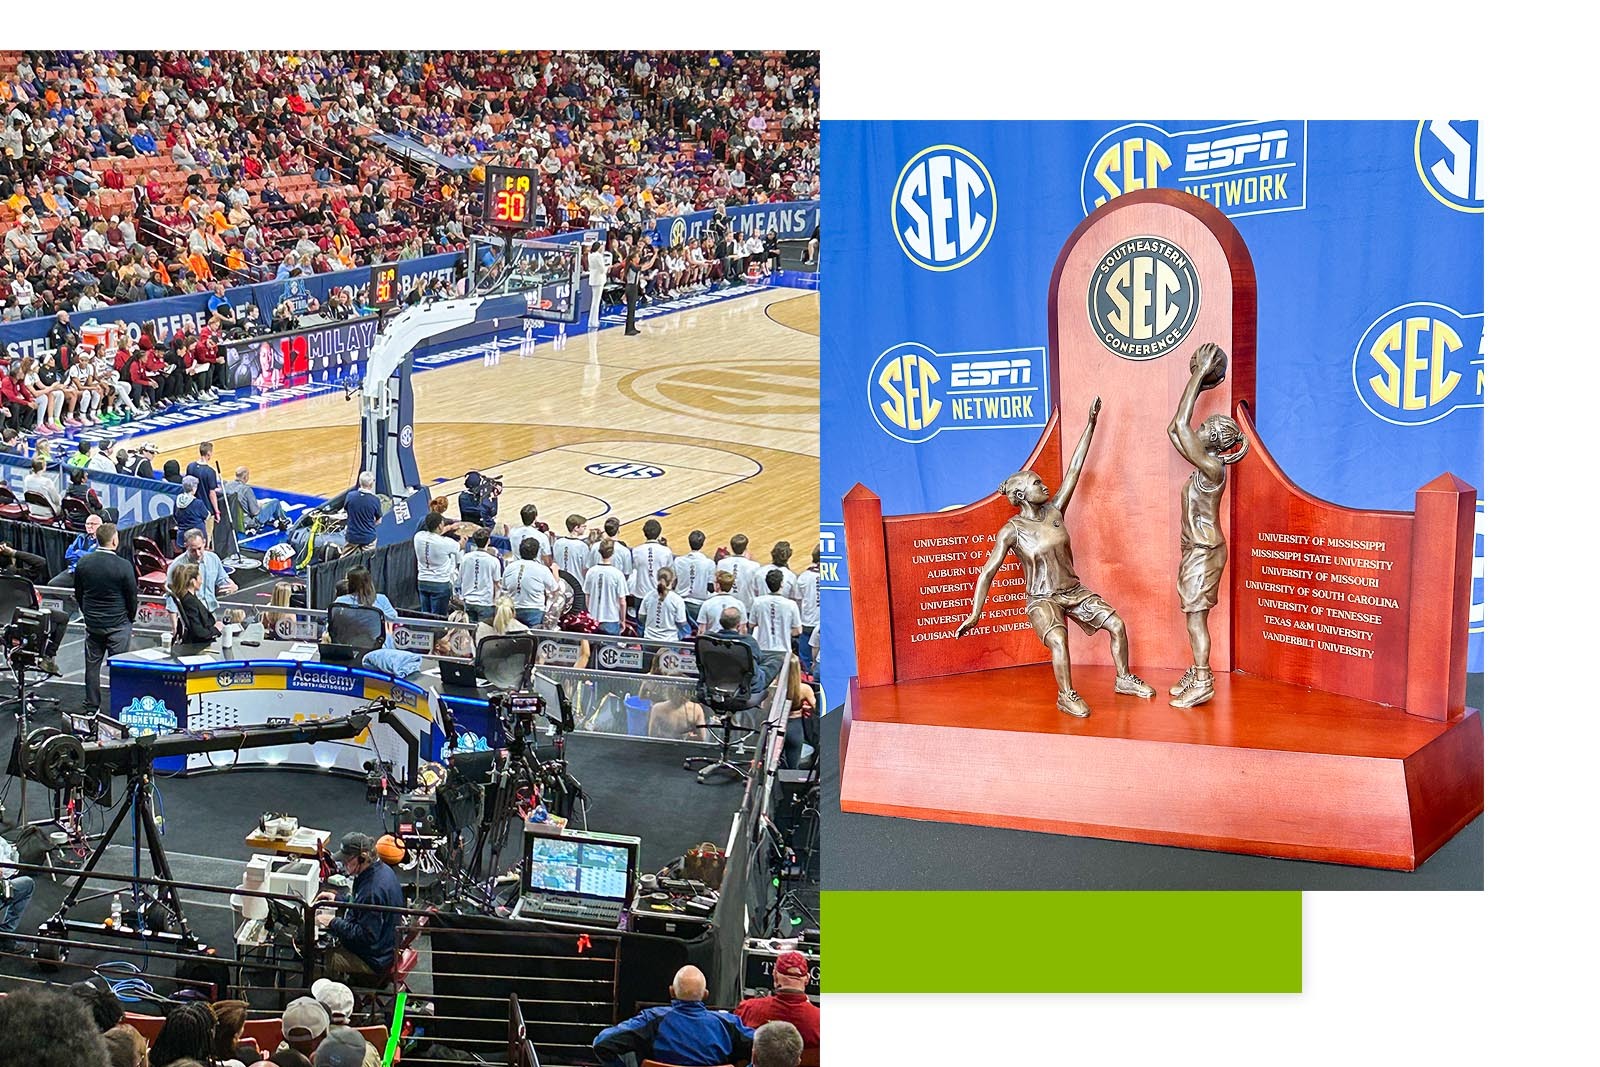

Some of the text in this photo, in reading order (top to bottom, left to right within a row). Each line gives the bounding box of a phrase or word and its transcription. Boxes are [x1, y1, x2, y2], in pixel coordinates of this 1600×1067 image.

[1185, 129, 1288, 172] ESPN
[900, 155, 987, 262] SEC
[741, 209, 806, 238] MEANS
[1101, 241, 1187, 274] SOUTHEASTERN
[1106, 257, 1181, 340] SEC
[281, 321, 379, 375] 12 MILAY
[1105, 328, 1182, 355] CONFERENCE
[1369, 317, 1463, 409] SEC
[878, 354, 942, 430] SEC
[951, 359, 1032, 387] ESPN
[952, 396, 1033, 420] NETWORK
[914, 536, 969, 548] UNIVERSITY
[972, 535, 984, 544] OF
[1258, 532, 1386, 552] UNIVERSITY OF MISSISSIPPI
[912, 552, 968, 564] UNIVERSITY
[970, 551, 982, 559] OF
[1252, 548, 1394, 571] MISSISSIPPI STATE UNIVERSITY
[928, 563, 1021, 578] AUBURN UNISITY
[1262, 566, 1379, 588] UNIVERSITY OF MISSOURI
[920, 582, 974, 595] UNIVERSITY
[1246, 580, 1400, 609] UNIVERSITY OF SOUTH CAROLINA
[920, 598, 974, 610] UNIVERSITY
[1258, 598, 1382, 624] UNIVERSITY OF TENNESSEE
[395, 630, 409, 646] SEC
[1264, 615, 1374, 640] TEXAS A&M UNIVERSITY
[602, 649, 618, 665] SEC
[1262, 631, 1374, 659] VANDERBILT UNIVERSITY
[293, 669, 356, 690] Academy
